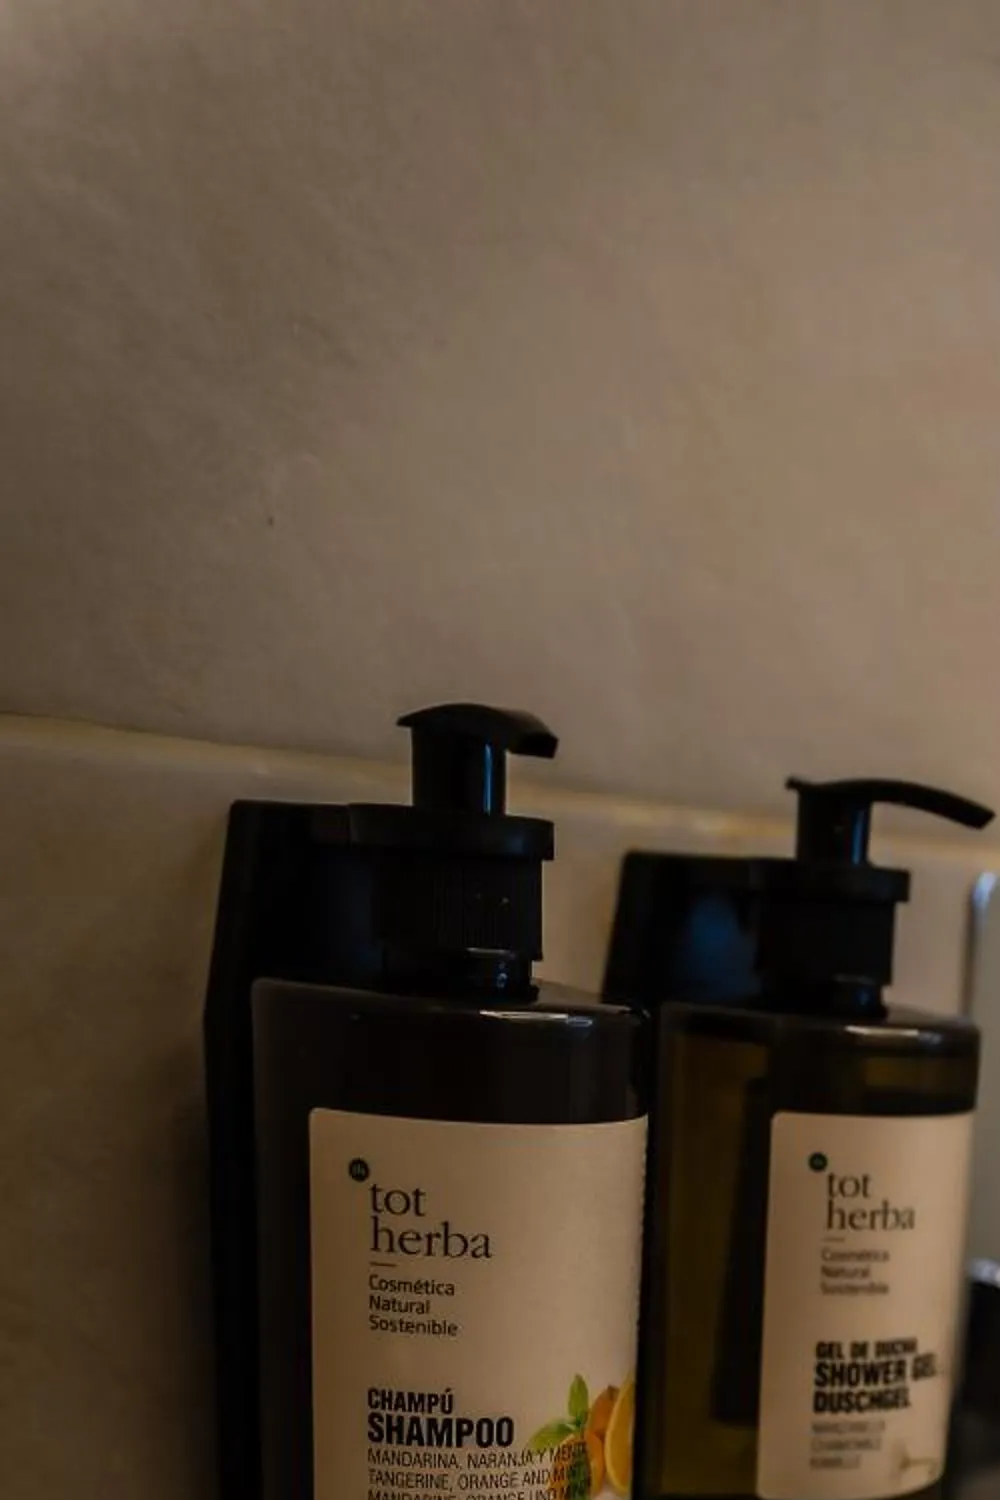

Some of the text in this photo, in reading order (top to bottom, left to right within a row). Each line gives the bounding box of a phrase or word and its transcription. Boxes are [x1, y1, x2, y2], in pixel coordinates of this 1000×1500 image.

[828, 1173, 870, 1198] tot
[370, 1183, 426, 1217] tot
[827, 1200, 916, 1230] herba
[370, 1216, 493, 1258] herba
[369, 1274, 455, 1296] Cosmética
[369, 1295, 431, 1314] Natural
[369, 1315, 459, 1336] Sostenible
[815, 1360, 906, 1387] SHOWER
[367, 1388, 453, 1414] CHAMPÚ
[367, 1413, 514, 1448] SHAMPOO
[467, 1449, 534, 1469] NARANJA
[458, 1472, 520, 1490] ORANGE
[522, 1470, 550, 1486] AND
